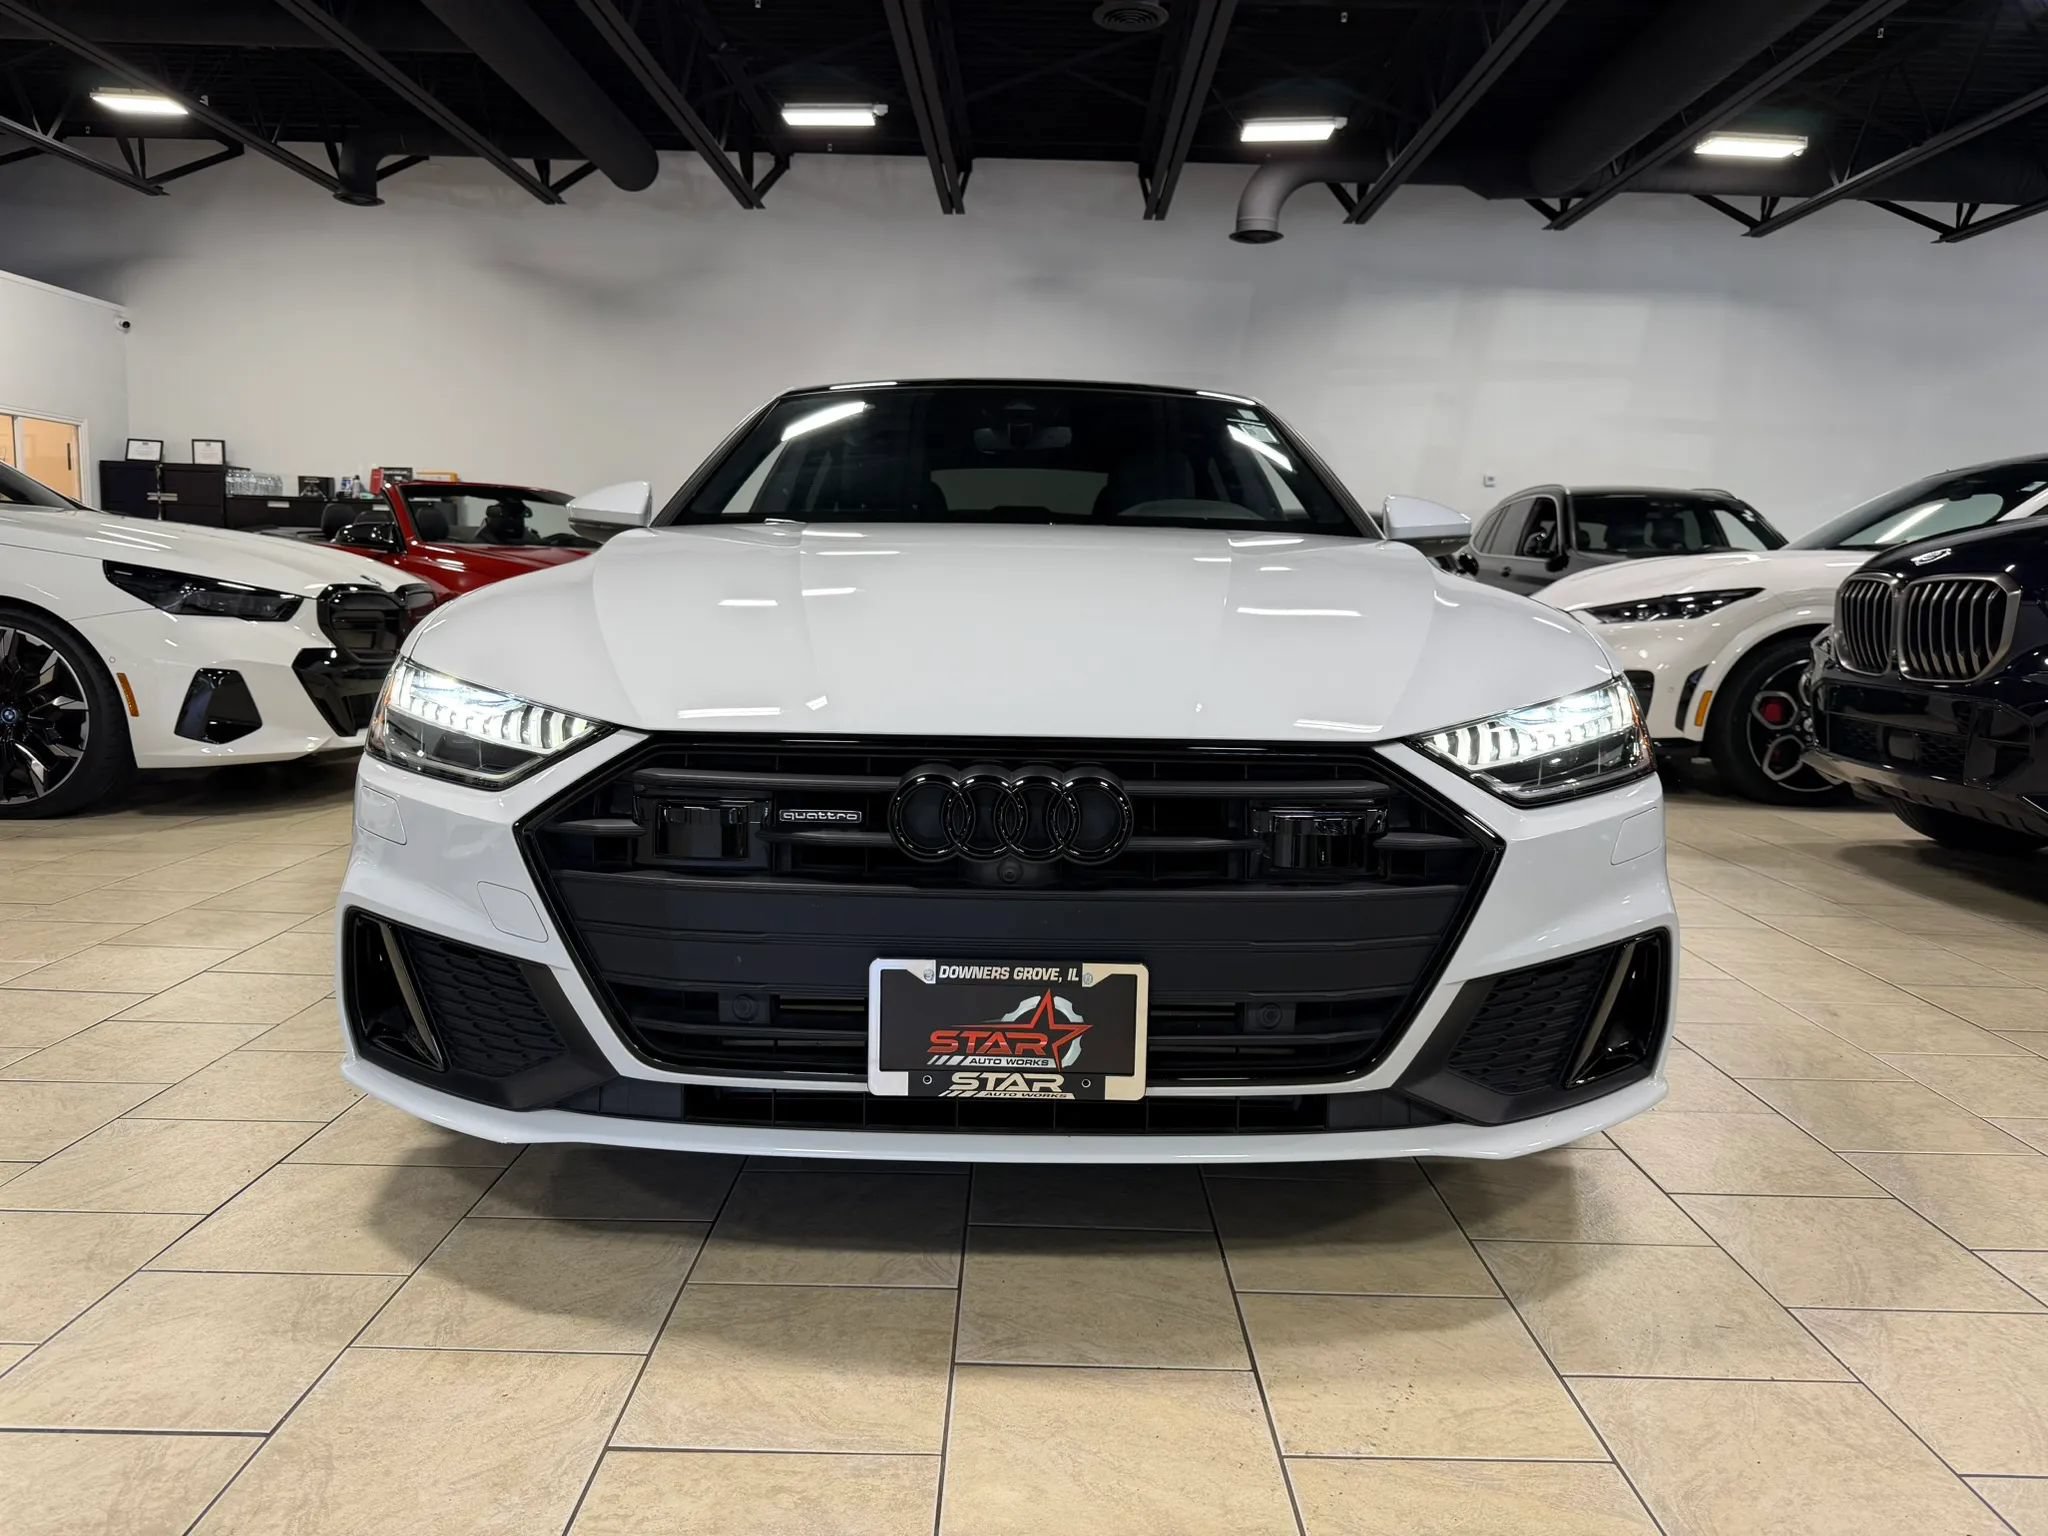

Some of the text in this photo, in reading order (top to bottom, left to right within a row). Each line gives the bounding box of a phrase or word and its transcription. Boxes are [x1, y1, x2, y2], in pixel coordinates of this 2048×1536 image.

[783, 812, 858, 820] quattro
[938, 965, 1080, 983] DOWNERS GROVE, IL
[927, 1030, 1049, 1055] STAR
[969, 1057, 1049, 1066] AUTO WORKS
[949, 1072, 1065, 1092] STAR
